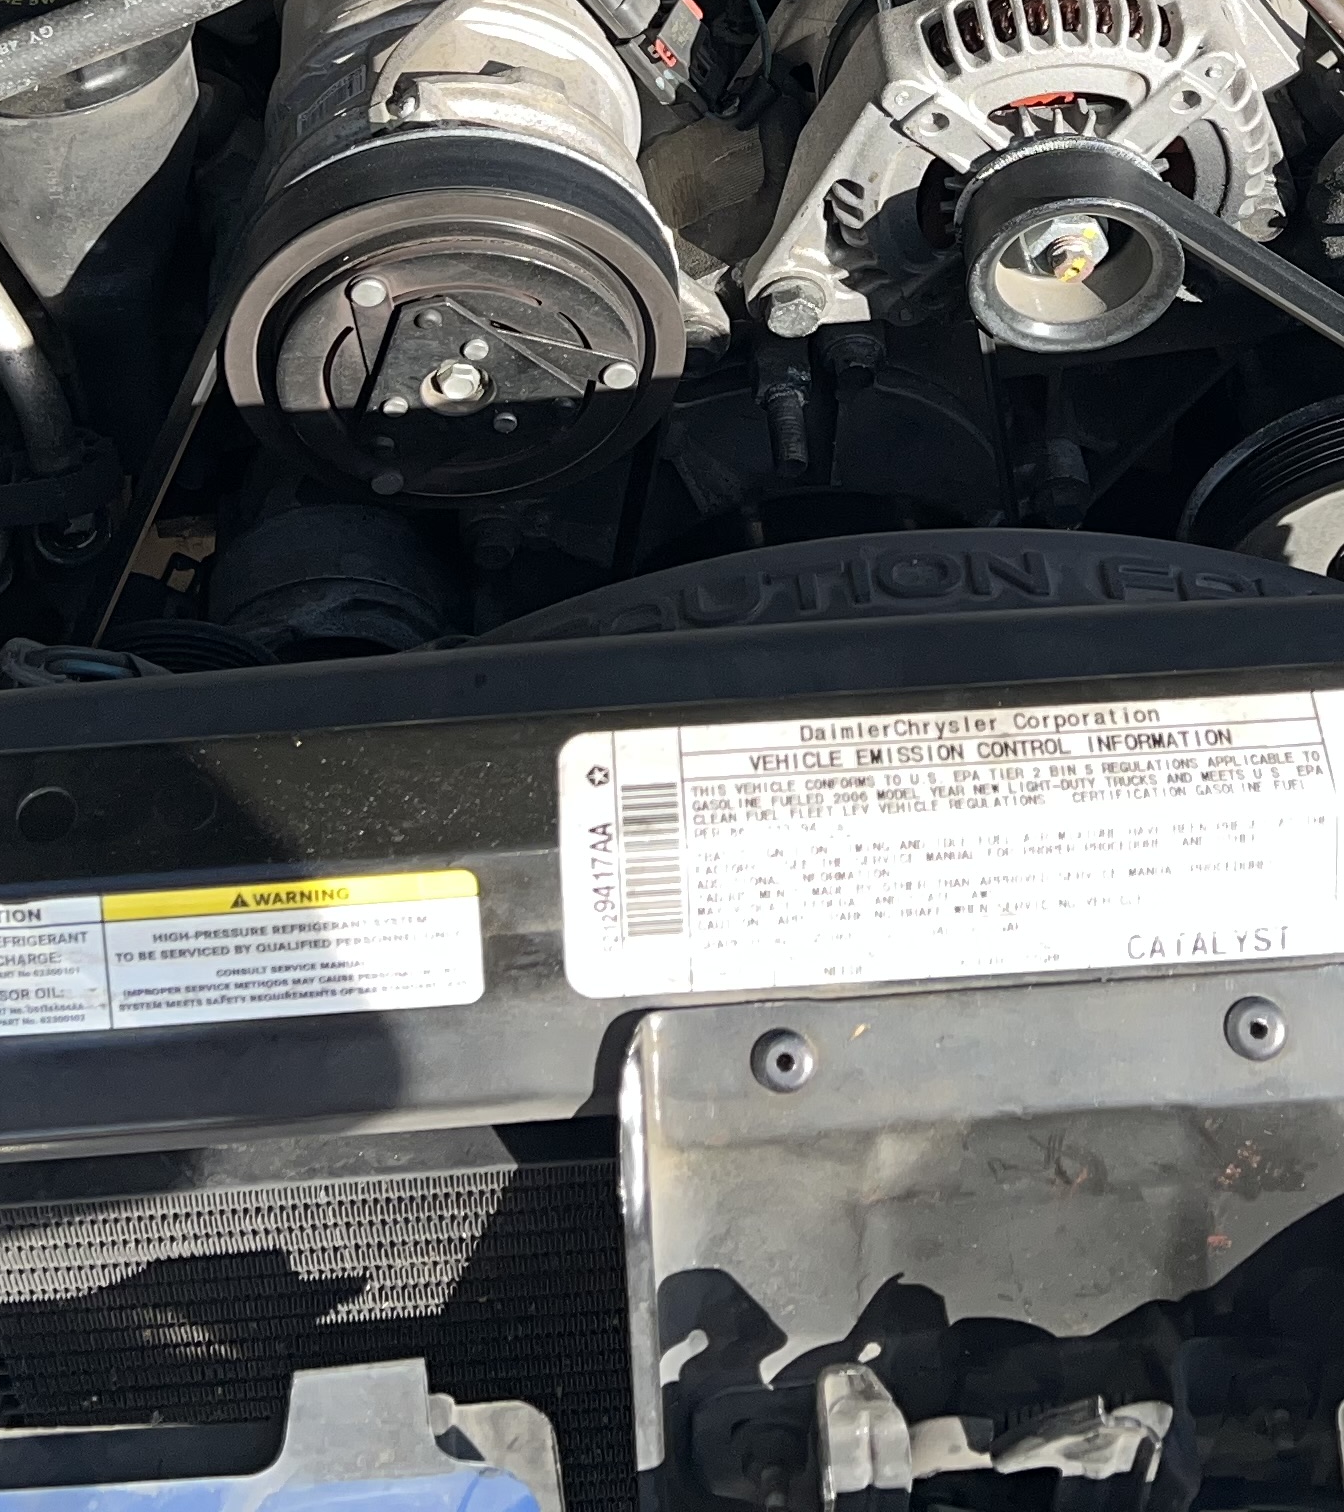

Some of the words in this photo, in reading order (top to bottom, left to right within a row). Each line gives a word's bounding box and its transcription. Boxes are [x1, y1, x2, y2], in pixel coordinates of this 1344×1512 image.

[28, 24, 54, 46] GY
[800, 714, 998, 743] DaimlerChrysler
[1013, 707, 1160, 733] Corporation
[750, 750, 843, 772] VEHICLE
[856, 745, 964, 767] EMISSION
[977, 737, 1071, 759] CONTROL
[1088, 728, 1234, 753] INFORMATION
[692, 784, 726, 797] THIS
[735, 780, 796, 796] VEHICLE
[805, 775, 875, 791] CONFORMS
[885, 774, 902, 786] TO
[953, 769, 980, 783] EPA
[989, 766, 1024, 781] TIER
[1033, 767, 1042, 780] 2
[1049, 764, 1077, 778] BIN
[1102, 757, 1199, 775] REGULATIONS
[1208, 751, 1295, 769] APPLICABLE
[1302, 750, 1321, 763] TO
[692, 797, 761, 813] GASOLINE
[771, 793, 824, 808] FUELED
[876, 788, 921, 801] MODEL
[929, 785, 966, 799] YEAR
[973, 783, 1000, 796] NEW
[1008, 778, 1096, 795] LIGHT-DUTY
[1106, 773, 1159, 789] TRUCKS
[1166, 770, 1193, 785] AND
[1201, 768, 1246, 782] MEETS
[1297, 763, 1324, 777] EPA
[879, 798, 939, 814] VEHICLE
[252, 887, 349, 907] WARNING
[153, 926, 269, 943] HIGH-PRESSURE
[1127, 925, 1289, 959] CATALYST
[115, 952, 135, 964] TO
[138, 951, 156, 962] BE
[160, 946, 231, 961] SERVICED
[234, 943, 253, 955] BY
[256, 938, 332, 954] QUALIFIED
[292, 976, 315, 986] MAY
